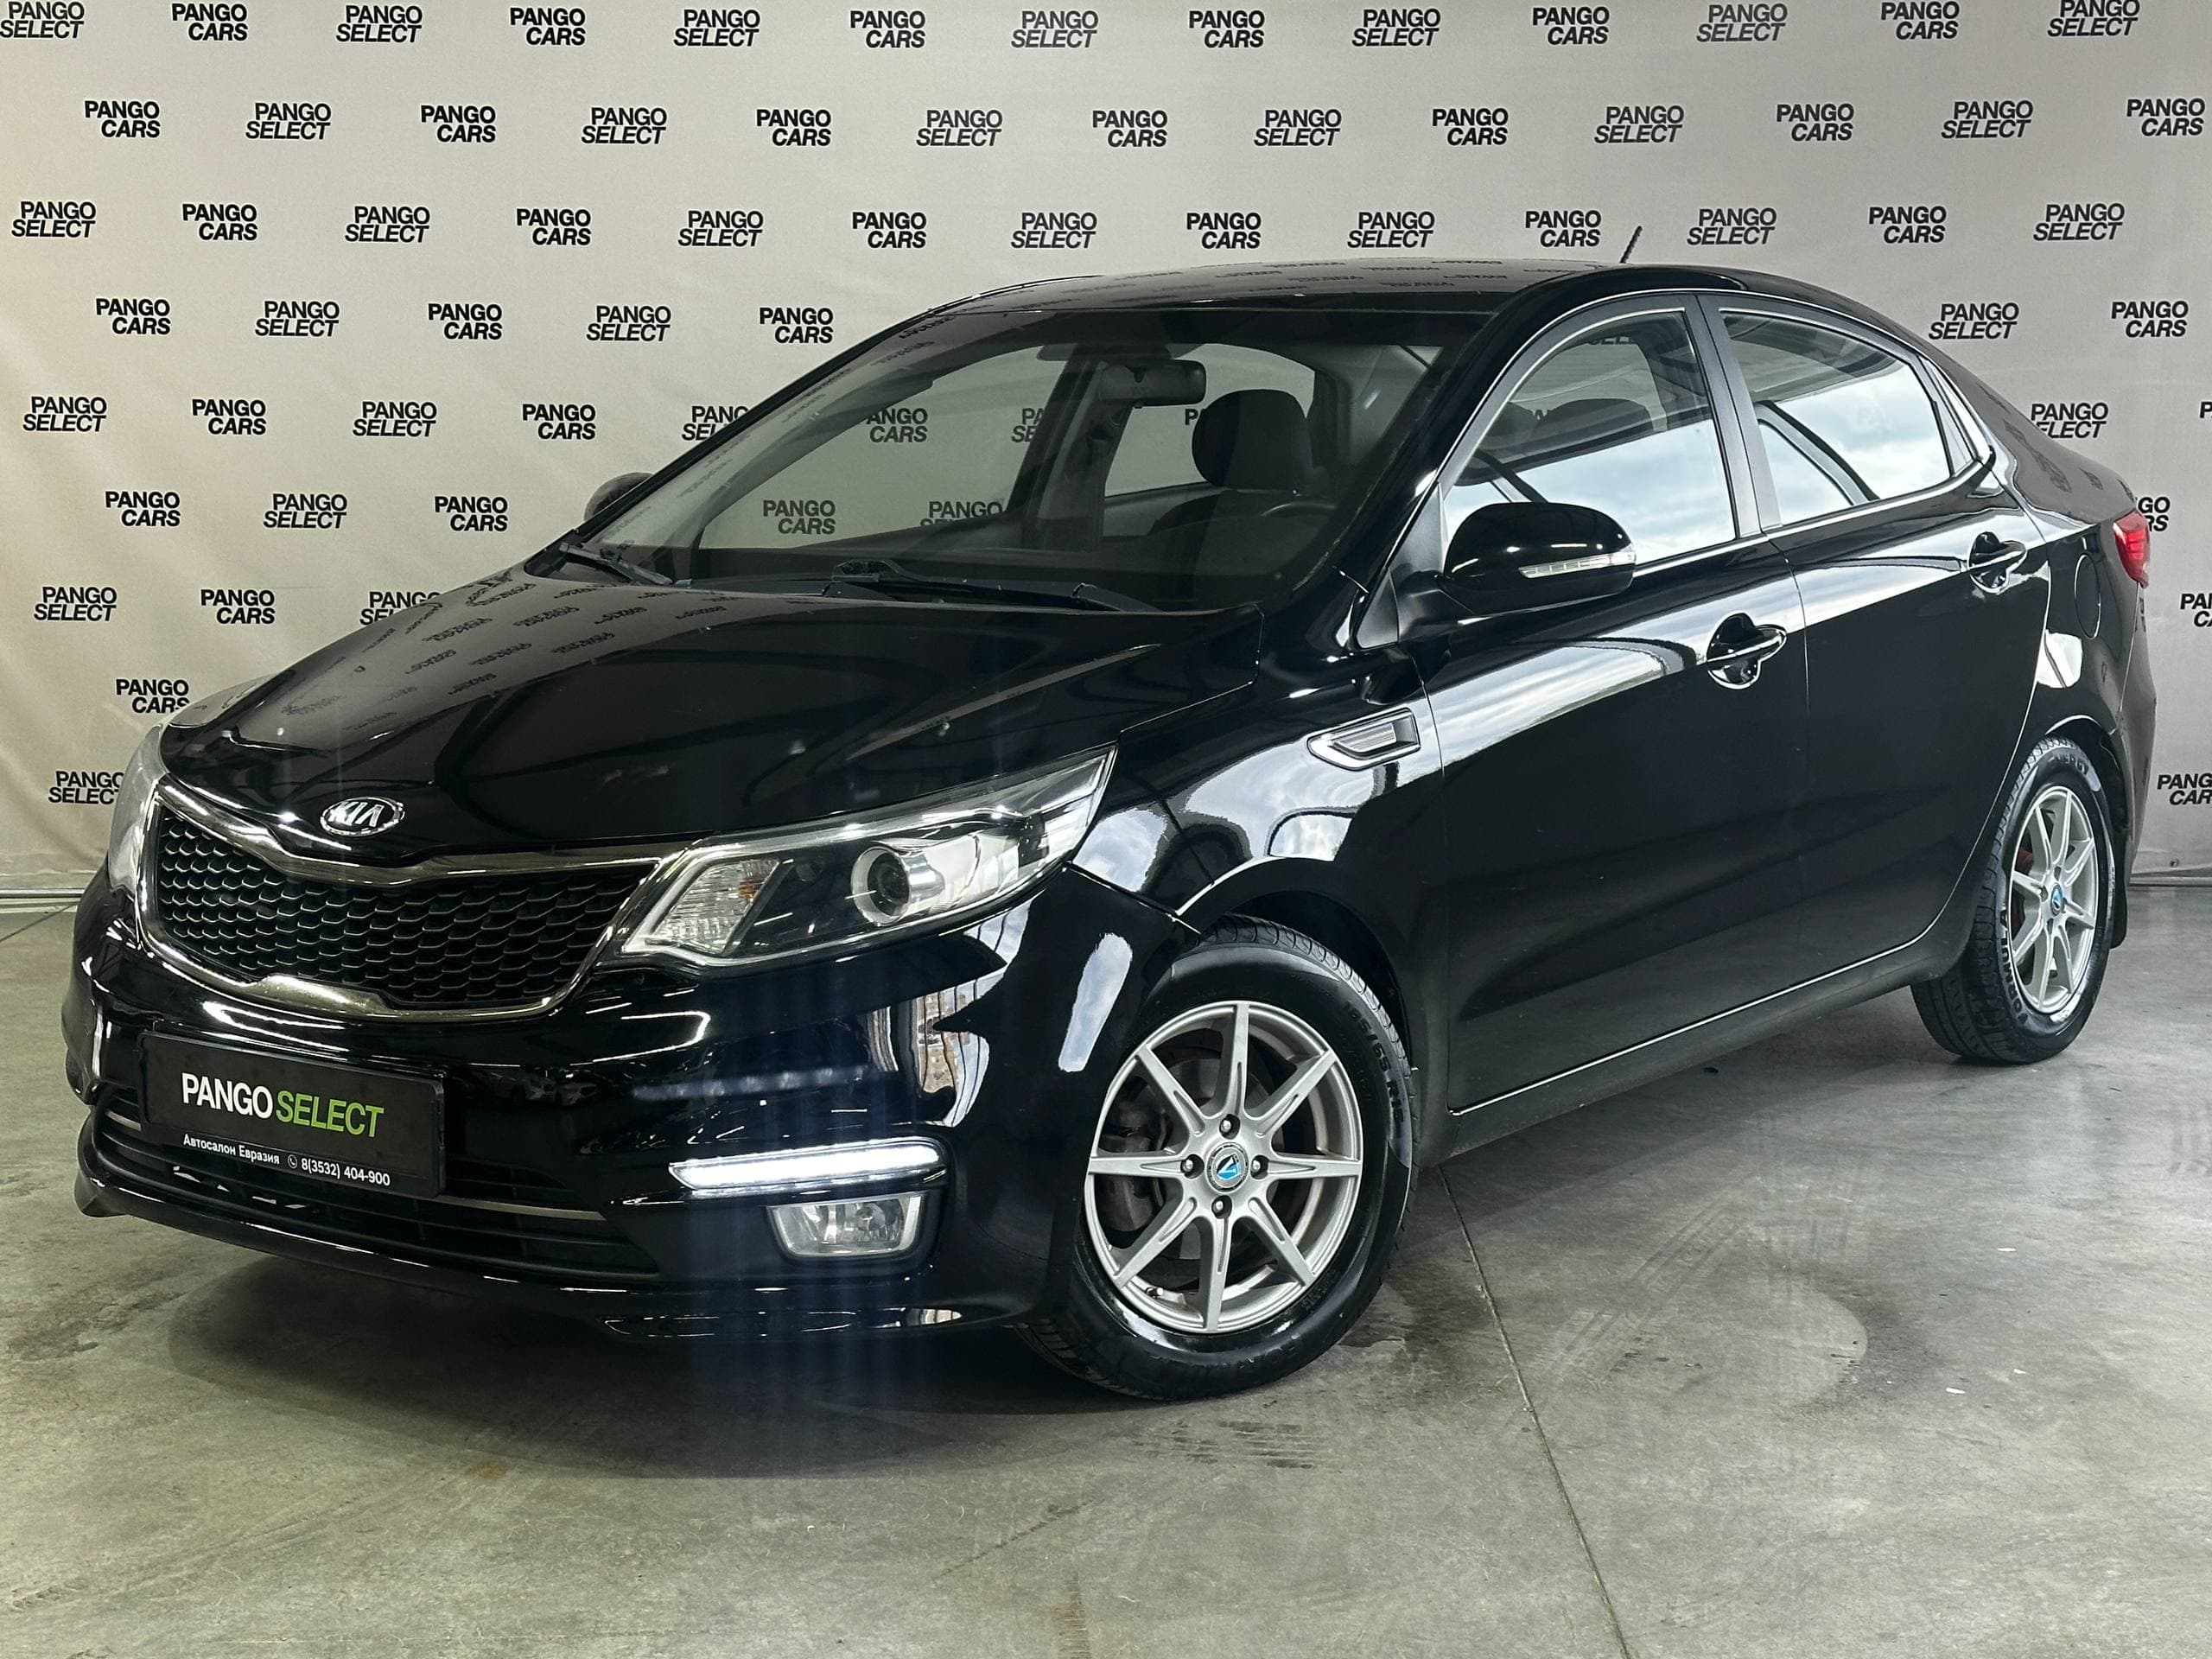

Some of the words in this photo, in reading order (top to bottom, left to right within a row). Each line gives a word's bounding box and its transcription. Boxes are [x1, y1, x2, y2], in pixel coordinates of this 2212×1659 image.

[9, 2, 85, 20] PANGO
[172, 3, 247, 22] PANGO
[346, 5, 423, 24] PANGO
[511, 8, 585, 26] PANGO
[1533, 7, 1609, 25] PANGO
[1709, 3, 1788, 22] PANGO
[1881, 1, 1960, 20] PANGO
[2060, 0, 2139, 17] PANGO
[684, 10, 760, 28] PANGO
[850, 10, 925, 29] PANGO
[1022, 10, 1098, 29] PANGO
[1189, 10, 1265, 29] PANGO
[1363, 9, 1440, 28] PANGO
[2048, 17, 2138, 36] SELECT
[0, 20, 84, 38] SELECT
[188, 22, 248, 41] CARS
[336, 23, 422, 42] SELECT
[526, 27, 586, 46] CARS
[674, 28, 760, 47] SELECT
[1351, 28, 1440, 47] SELECT
[1548, 26, 1609, 45] CARS
[1696, 22, 1786, 42] SELECT
[1896, 21, 1959, 40] CARS
[866, 30, 925, 48] CARS
[1011, 29, 1097, 48] SELECT
[1205, 29, 1264, 48] CARS
[85, 100, 160, 118] PANGO
[256, 103, 331, 121] PANGO
[421, 105, 495, 124] PANGO
[592, 107, 667, 125] PANGO
[1433, 108, 1509, 126] PANGO
[1606, 105, 1684, 124] PANGO
[1777, 104, 1854, 122] PANGO
[1954, 100, 2033, 119] PANGO
[2126, 99, 2205, 117] PANGO
[757, 109, 831, 127] PANGO
[927, 110, 1002, 128] PANGO
[1093, 111, 1167, 128] PANGO
[1265, 109, 1342, 127] PANGO
[101, 119, 161, 137] CARS
[245, 121, 331, 140] SELECT
[437, 124, 496, 143] CARS
[582, 125, 666, 144] SELECT
[1447, 127, 1508, 145] CARS
[1594, 124, 1682, 143] SELECT
[1791, 123, 1853, 141] CARS
[1942, 119, 2031, 138] SELECT
[2142, 118, 2204, 137] CARS
[772, 128, 831, 146] CARS
[916, 128, 1002, 146] SELECT
[1108, 130, 1167, 147] CARS
[1254, 128, 1340, 146] SELECT
[21, 201, 96, 219] PANGO
[182, 204, 257, 222] PANGO
[355, 206, 430, 225] PANGO
[517, 208, 591, 226] PANGO
[1526, 210, 1601, 228] PANGO
[1699, 207, 1777, 226] PANGO
[1869, 207, 1946, 225] PANGO
[2046, 203, 2125, 222] PANGO
[11, 219, 96, 238] SELECT
[689, 211, 763, 228] PANGO
[853, 212, 926, 230] PANGO
[1022, 213, 1097, 230] PANGO
[1187, 213, 1262, 230] PANGO
[1358, 212, 1434, 230] PANGO
[199, 222, 257, 240] CARS
[345, 224, 429, 243] SELECT
[532, 227, 591, 245] CARS
[677, 228, 763, 247] SELECT
[868, 231, 926, 248] CARS
[1011, 231, 1096, 248] SELECT
[1347, 230, 1433, 248] SELECT
[1541, 229, 1600, 247] CARS
[1687, 226, 1775, 245] SELECT
[1884, 226, 1945, 244] CARS
[2033, 222, 2123, 241] SELECT
[1202, 232, 1261, 249] CARS
[96, 298, 170, 316] PANGO
[264, 301, 340, 319] PANGO
[429, 303, 502, 321] PANGO
[597, 306, 671, 323] PANGO
[1941, 302, 2019, 321] PANGO
[2112, 301, 2189, 319] PANGO
[112, 317, 171, 334] CARS
[760, 308, 833, 325] PANGO
[255, 319, 339, 337] SELECT
[444, 322, 502, 340] CARS
[587, 323, 671, 341] SELECT
[775, 326, 834, 343] CARS
[1929, 321, 2017, 340] SELECT
[2126, 320, 2187, 338] CARS
[31, 397, 106, 414] PANGO
[192, 399, 266, 416] PANGO
[363, 401, 436, 419] PANGO
[523, 404, 595, 422] PANGO
[2031, 402, 2108, 421] PANGO
[22, 414, 106, 432] SELECT
[866, 408, 928, 425] ANGO
[208, 417, 266, 435] CARS
[353, 419, 436, 437] SELECT
[538, 423, 596, 440] CARS
[869, 425, 928, 443] CARS
[2036, 421, 2107, 439] ELECT
[105, 492, 180, 508] PANGO
[273, 493, 347, 512] PANGO
[435, 496, 507, 513] PANGO
[764, 500, 835, 517] PANGO
[122, 509, 181, 526] CARS
[929, 501, 1003, 518] PANGO
[264, 511, 346, 529] SELECT
[450, 514, 508, 531] CARS
[779, 518, 836, 533] CARS
[42, 587, 117, 604] PANGO
[201, 589, 275, 607] PANGO
[34, 604, 117, 621] SELECT
[217, 607, 276, 624] CARS
[116, 679, 189, 696] PANGO
[2157, 773, 2212, 790] PANG
[48, 787, 119, 804] SELEC
[2170, 789, 2212, 805] CAR
[327, 801, 385, 828] KIA
[181, 1072, 273, 1119] PANGO
[276, 1090, 385, 1138] SELECT
[183, 1133, 236, 1156] Автосалон
[238, 1144, 280, 1165] Евразия
[301, 1158, 340, 1179] 8(3532)
[343, 1166, 391, 1186] 404-900
